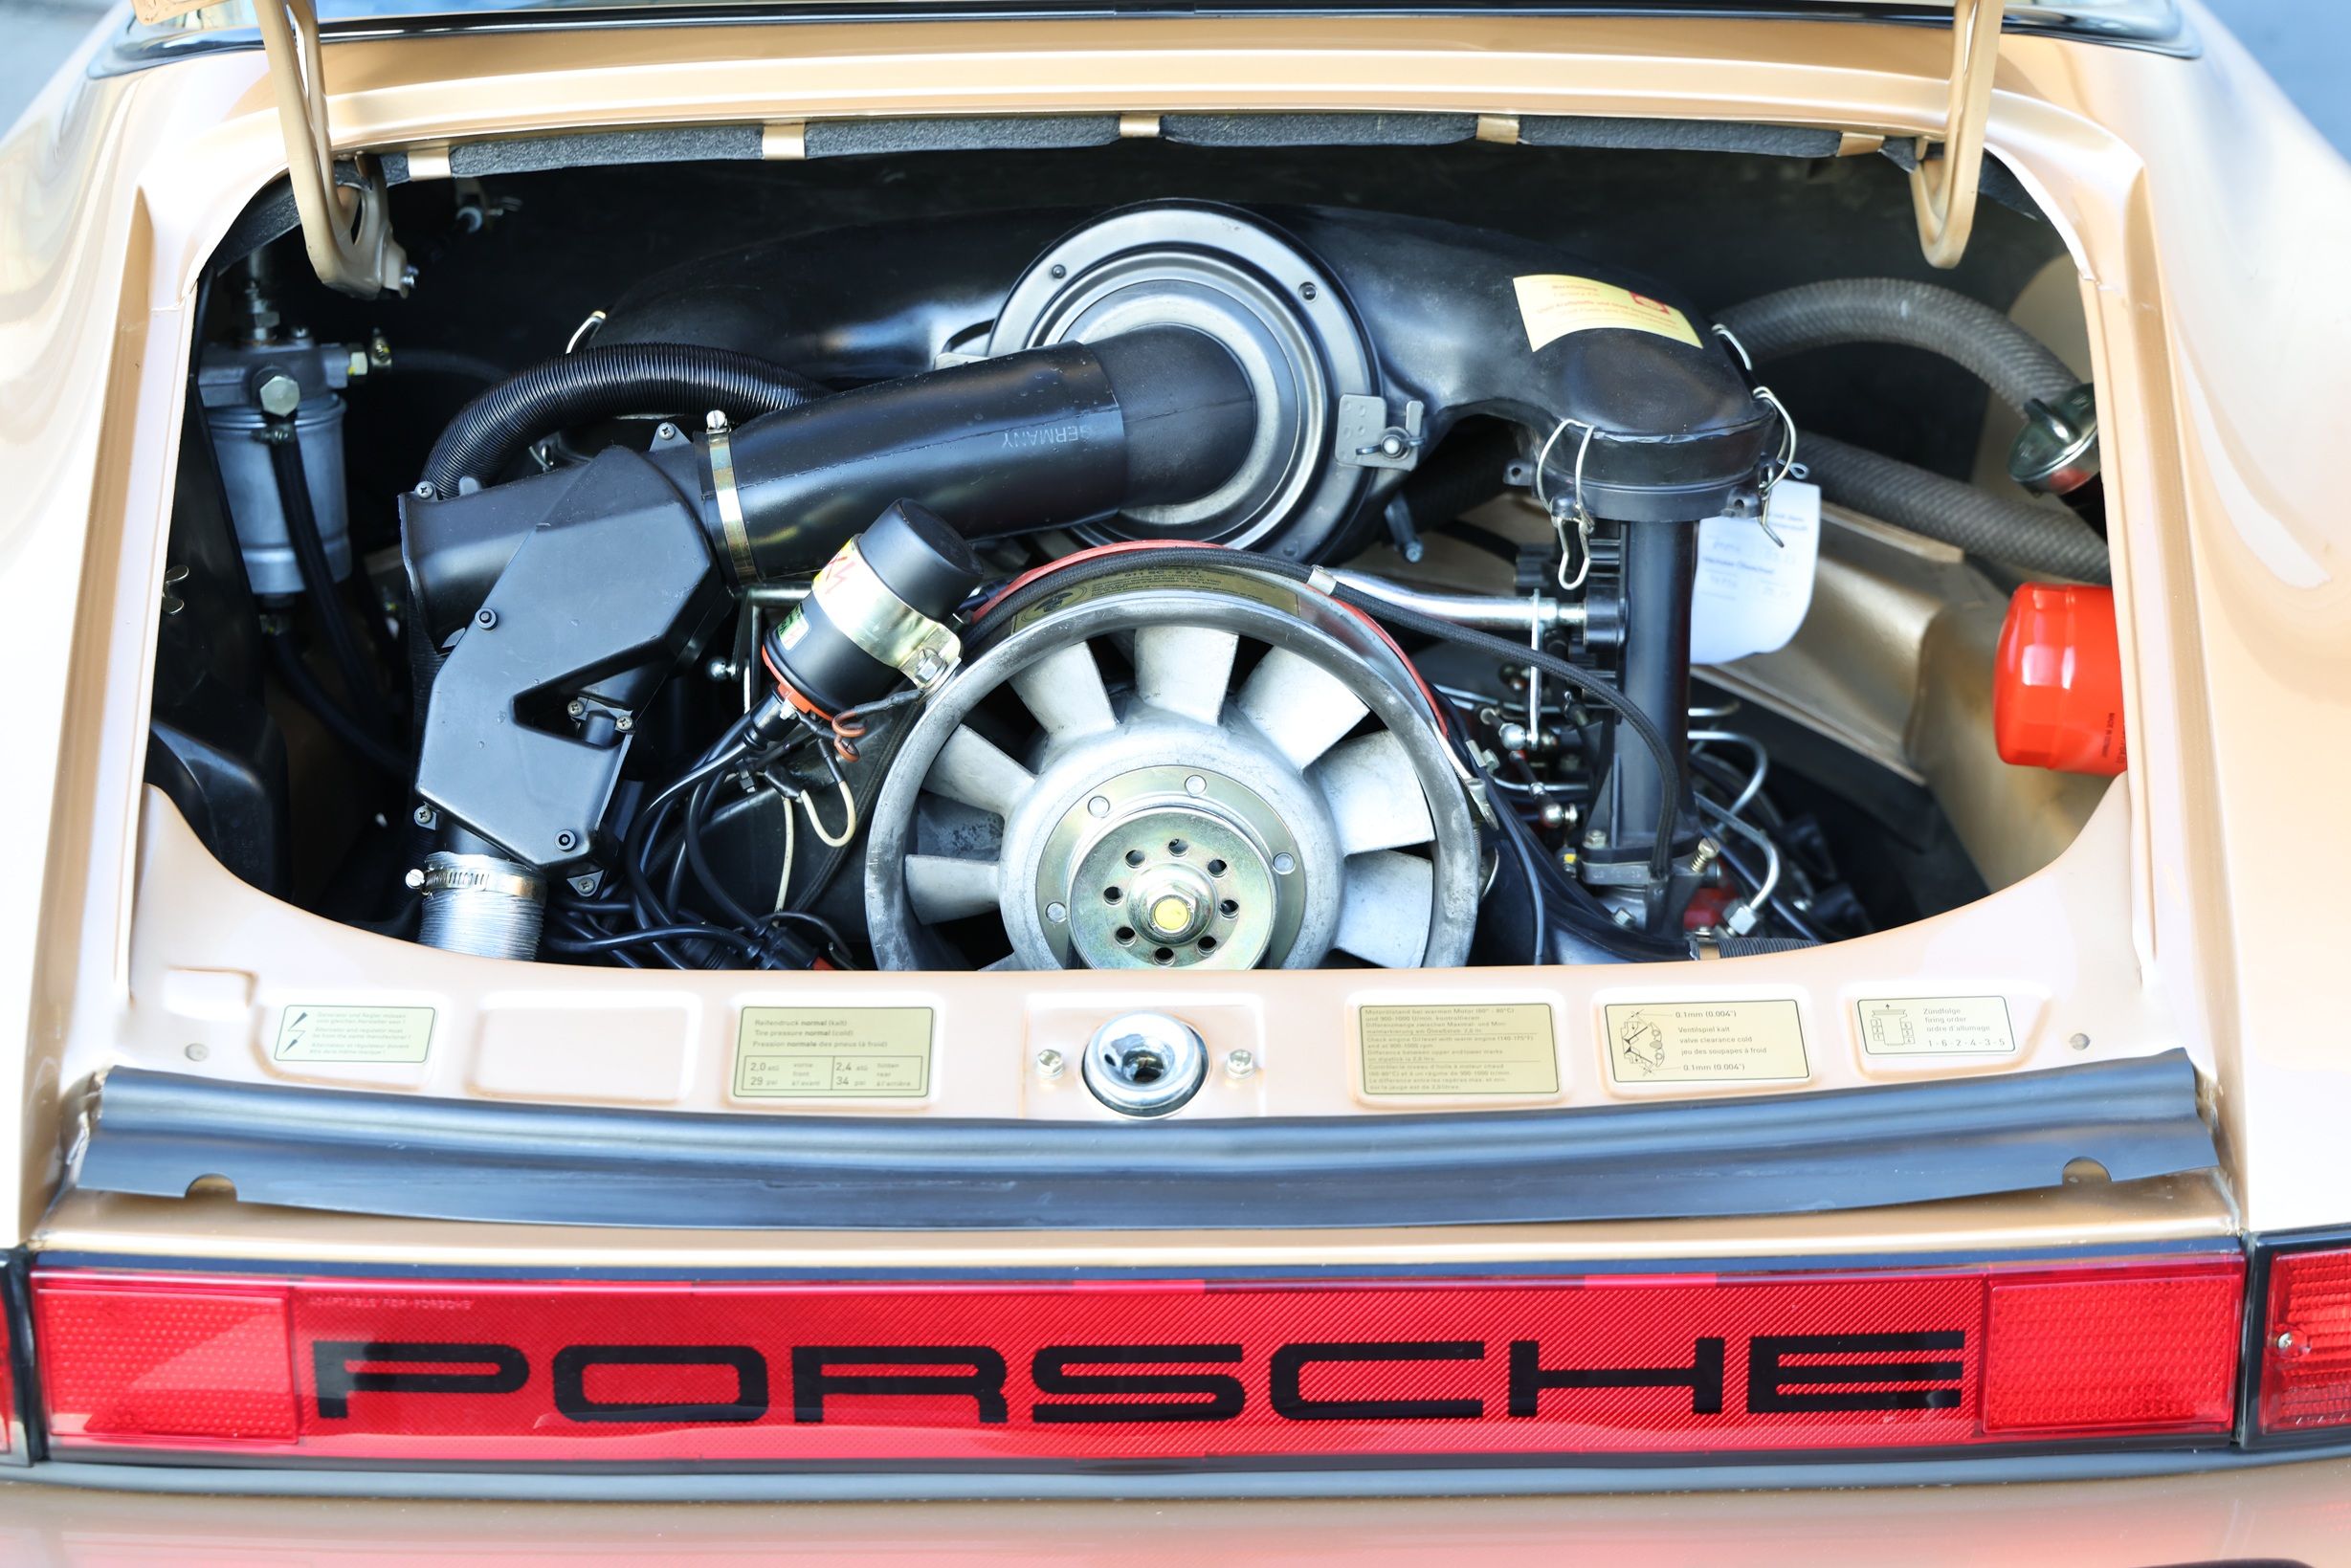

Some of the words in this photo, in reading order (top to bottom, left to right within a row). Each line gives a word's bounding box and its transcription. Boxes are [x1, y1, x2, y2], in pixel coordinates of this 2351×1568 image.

[750, 1076, 764, 1085] 29
[836, 1076, 850, 1085] 34
[312, 1331, 1965, 1424] PORSCHE
